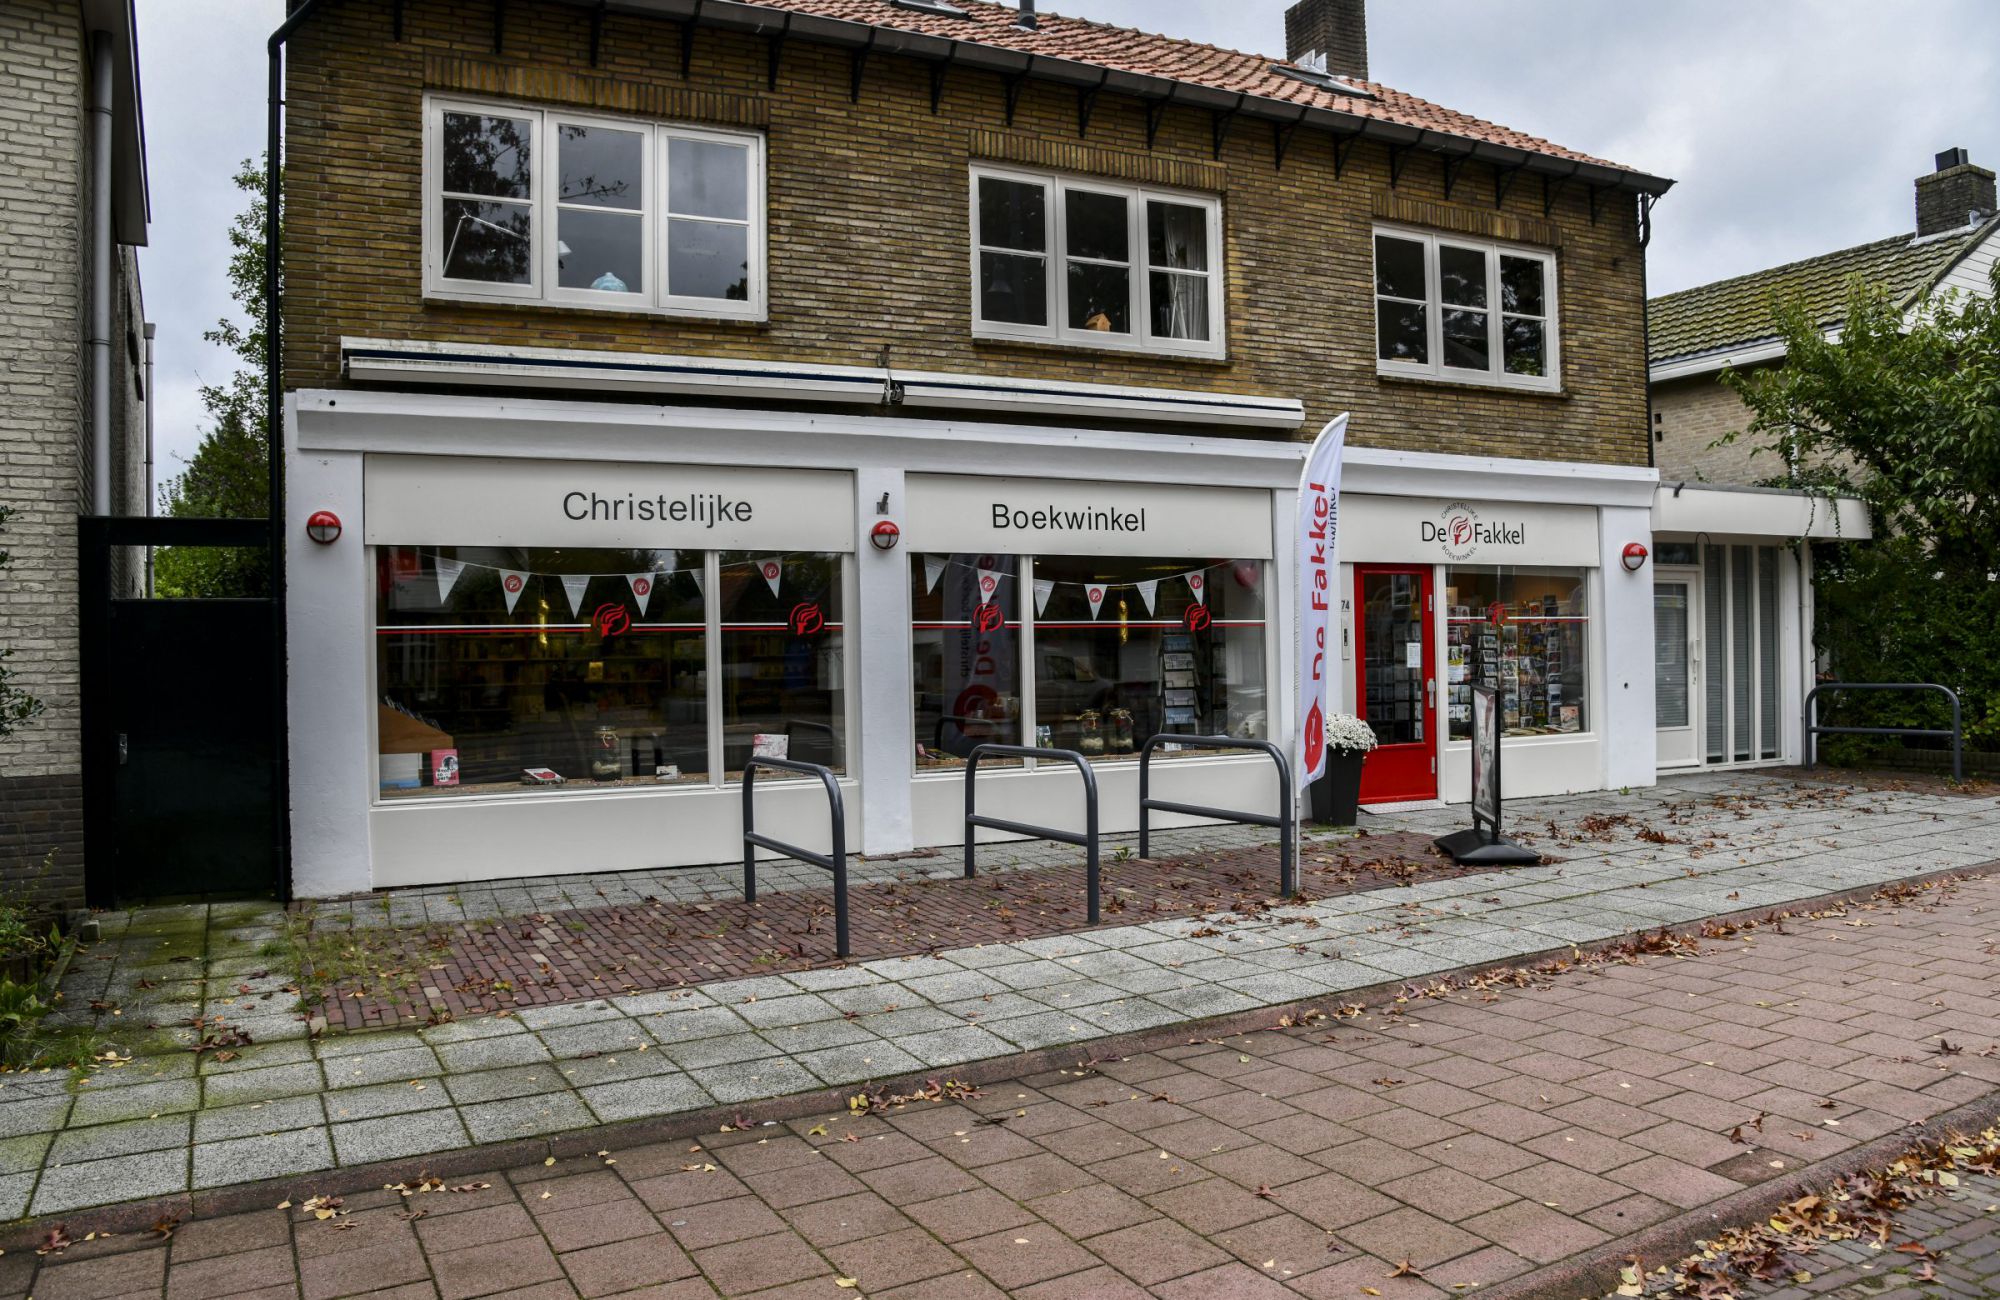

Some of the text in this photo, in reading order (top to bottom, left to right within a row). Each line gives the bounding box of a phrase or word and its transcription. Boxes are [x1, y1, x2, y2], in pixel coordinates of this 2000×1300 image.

[564, 492, 753, 528] Christelijke
[993, 503, 1145, 532] Boekwinkel
[1309, 482, 1329, 611] Fakkel
[1421, 521, 1525, 545] De Fakkel
[1341, 600, 1350, 610] 74
